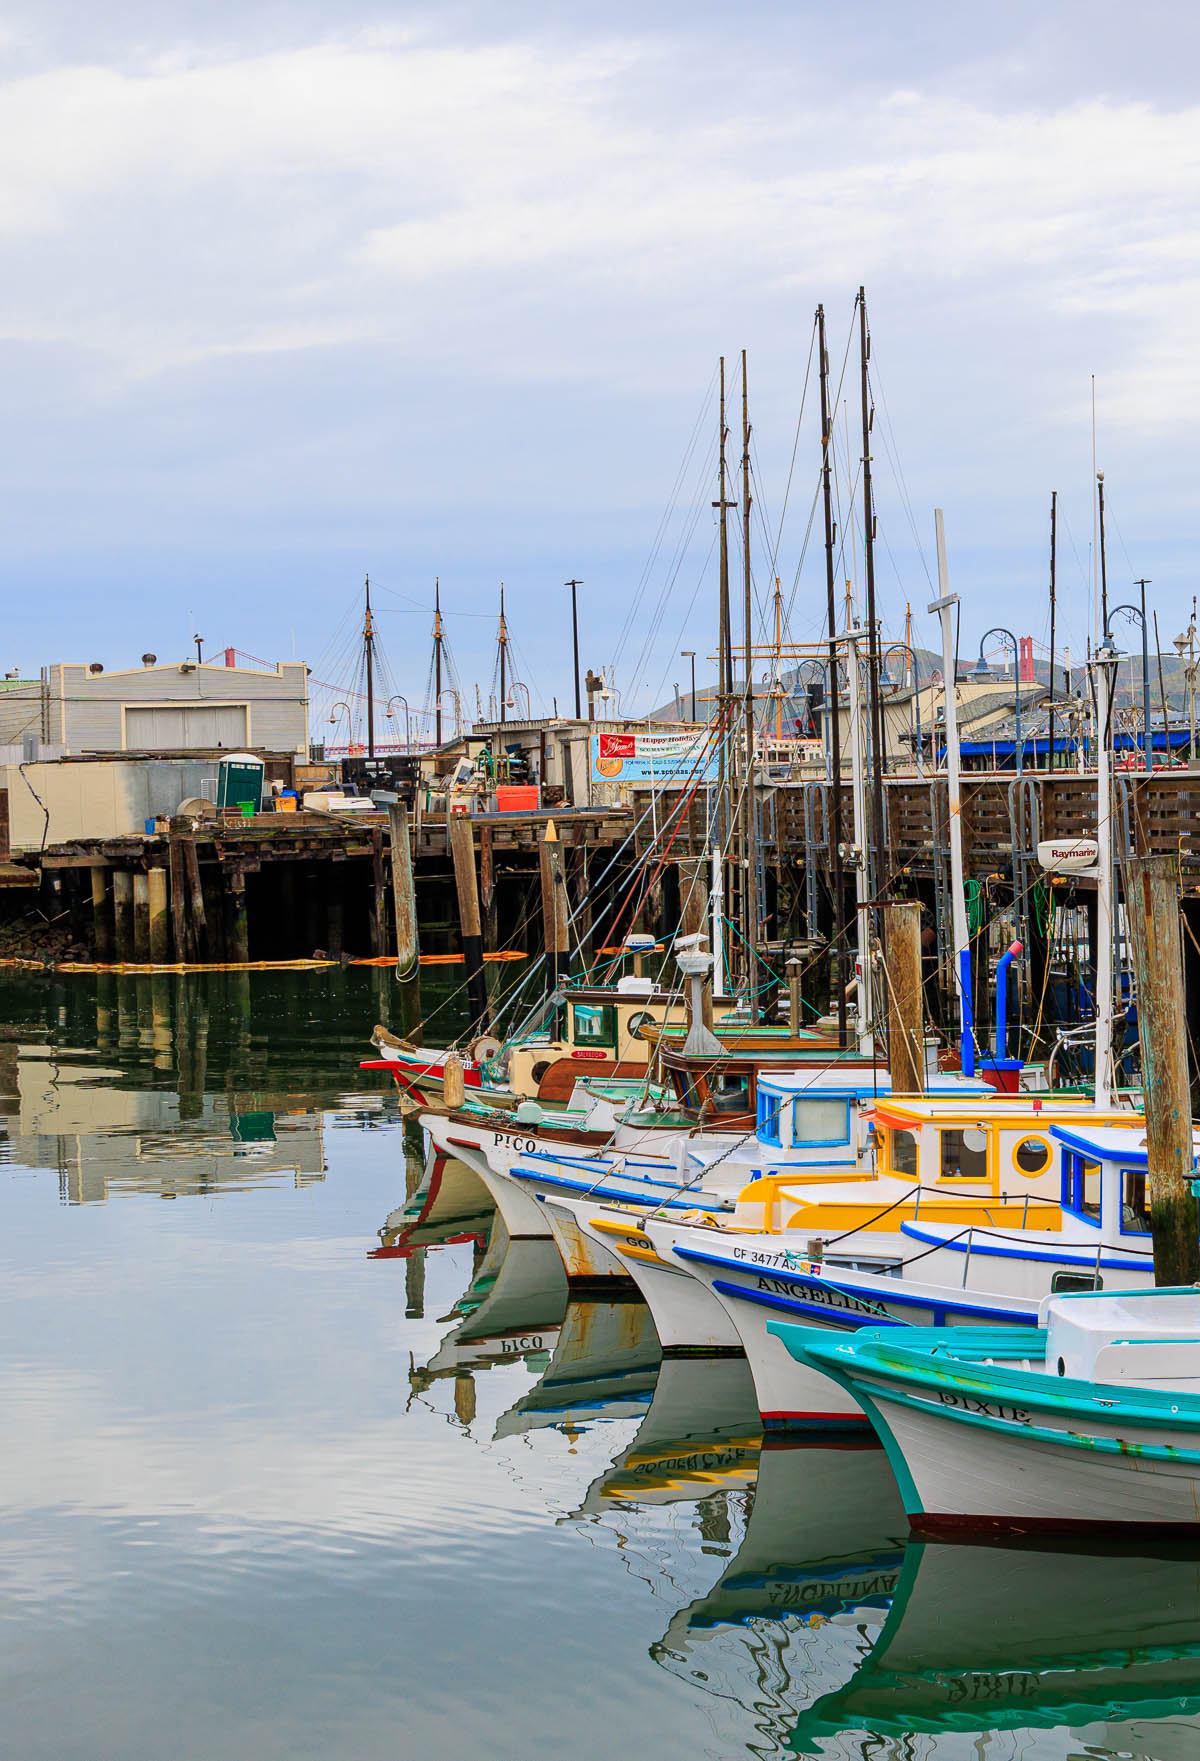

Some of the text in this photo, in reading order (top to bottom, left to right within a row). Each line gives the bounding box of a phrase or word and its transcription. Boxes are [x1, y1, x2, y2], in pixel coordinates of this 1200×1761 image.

[1051, 848, 1096, 859] Raymarine
[494, 1133, 536, 1153] PICO
[734, 1247, 747, 1259] CF
[751, 1251, 780, 1267] 3477
[781, 1258, 797, 1271] AJ
[757, 1277, 890, 1317] ANGELINA
[938, 1391, 1033, 1423] DIXIE
